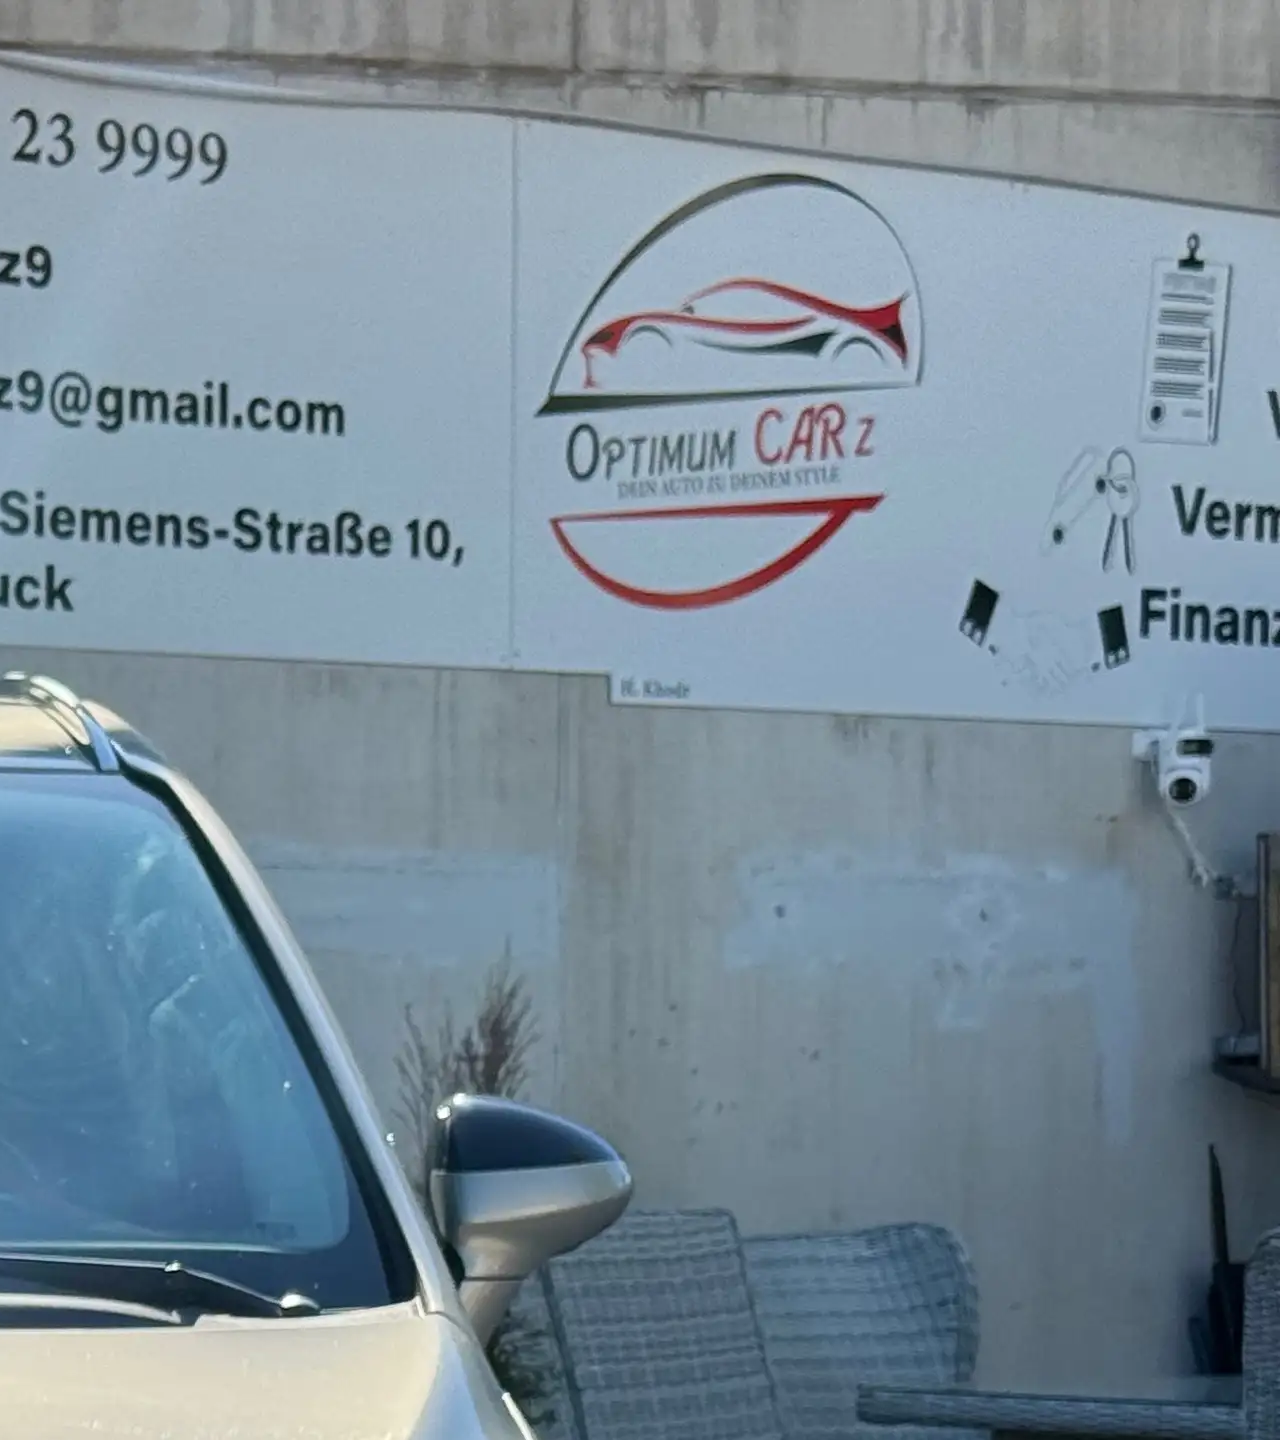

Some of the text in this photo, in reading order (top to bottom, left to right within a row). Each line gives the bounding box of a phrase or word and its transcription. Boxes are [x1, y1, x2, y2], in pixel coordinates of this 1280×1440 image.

[11, 108, 76, 167] 23
[96, 118, 228, 185] 9999
[406, 517, 465, 568] 10,
